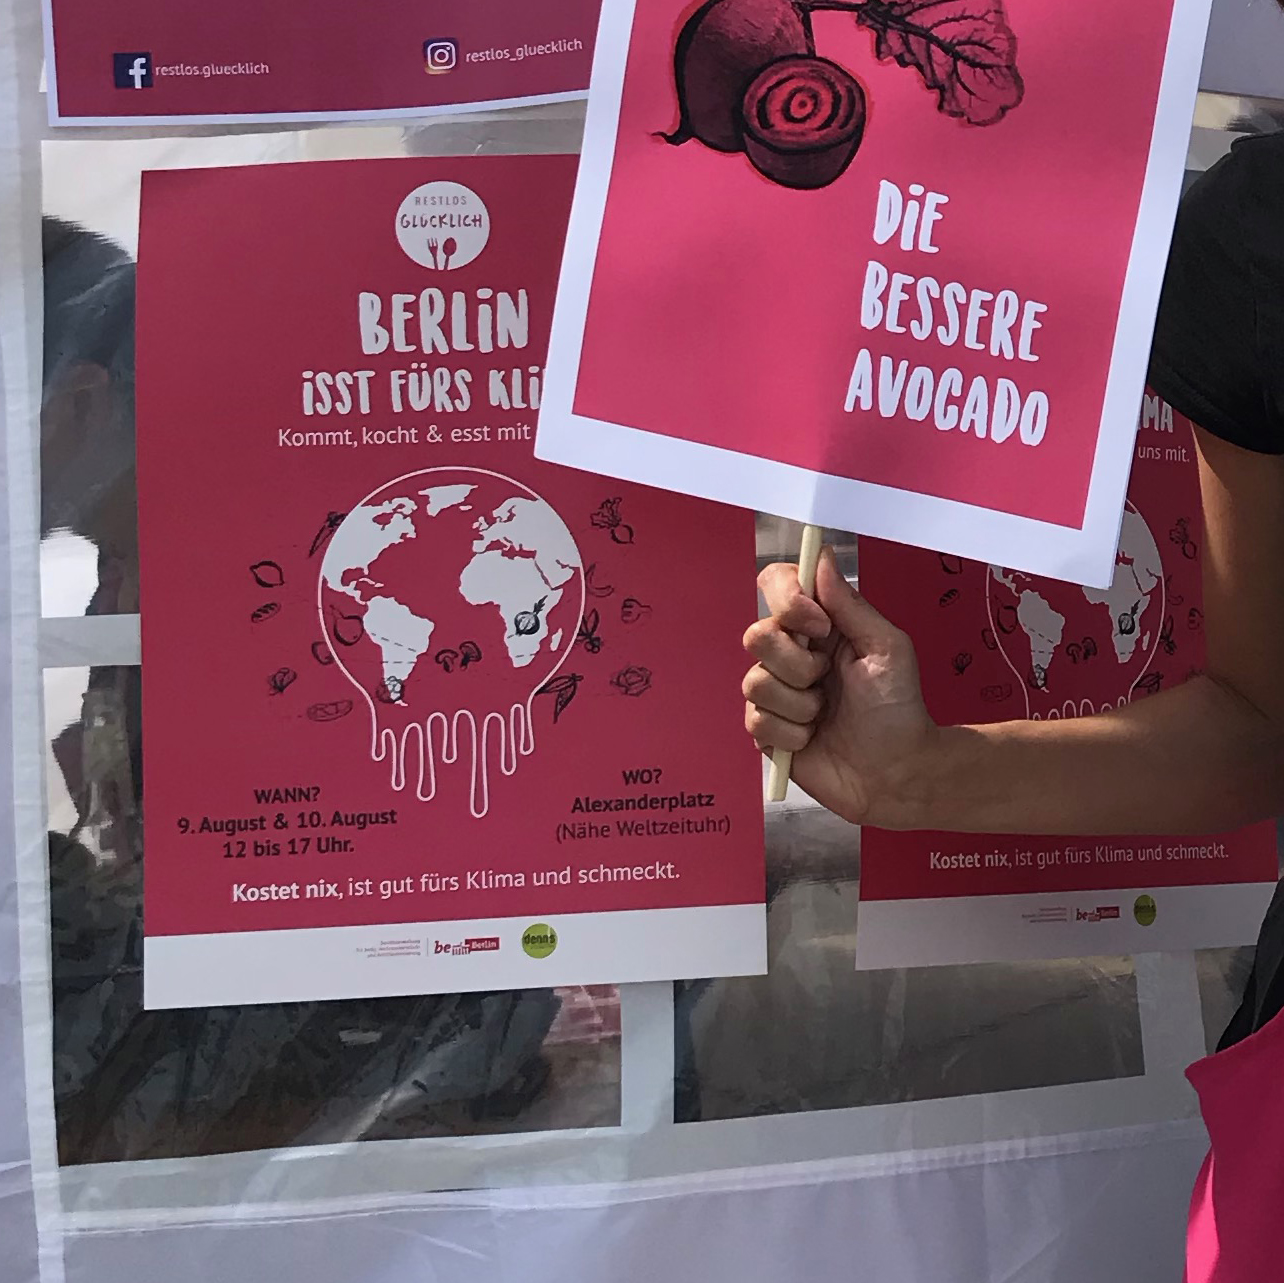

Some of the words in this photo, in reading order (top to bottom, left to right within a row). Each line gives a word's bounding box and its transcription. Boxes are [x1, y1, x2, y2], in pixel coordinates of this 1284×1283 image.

[466, 38, 582, 63] restlos_gluecklich
[155, 61, 269, 77] restlos.gluecklich
[414, 194, 467, 207] RESTLOS
[400, 212, 483, 230] GLÜCKLICH
[860, 260, 1048, 361] BESSERE
[391, 363, 472, 412] FÜRS
[844, 349, 1049, 446] AVOCADO
[278, 427, 358, 448] Kommt,
[362, 426, 418, 446] kocht
[427, 426, 443, 443] &
[450, 426, 491, 442] esst
[498, 422, 531, 441] mit
[1138, 445, 1161, 460] uns
[1165, 445, 1190, 463] mit.
[622, 769, 662, 786] WO?
[254, 787, 320, 805] WANN?
[571, 792, 715, 816] Alexanderplatz
[198, 814, 268, 836] August
[272, 813, 289, 831] &
[331, 809, 397, 830] August
[555, 820, 611, 843] (Nähe
[616, 815, 731, 840] Weltzeituhr)
[223, 840, 247, 859] 12
[253, 838, 280, 857] bis
[287, 837, 310, 855] 17
[317, 836, 354, 854] Uhr.
[930, 851, 980, 869] Kostet
[985, 851, 1012, 869] nix,
[1015, 848, 1032, 865] ist
[1037, 849, 1060, 869] gut
[1065, 846, 1091, 863] fürs
[1096, 845, 1133, 862] Klima
[1138, 844, 1162, 861] und
[1166, 842, 1229, 860] schmeckt.
[232, 882, 299, 902] Kostet
[306, 878, 343, 899] nix,
[348, 876, 373, 896] ist
[379, 876, 413, 898] gut
[420, 872, 459, 893] fürs
[466, 868, 525, 890] Klima
[532, 866, 571, 886] und
[577, 861, 680, 884] schmeckt.
